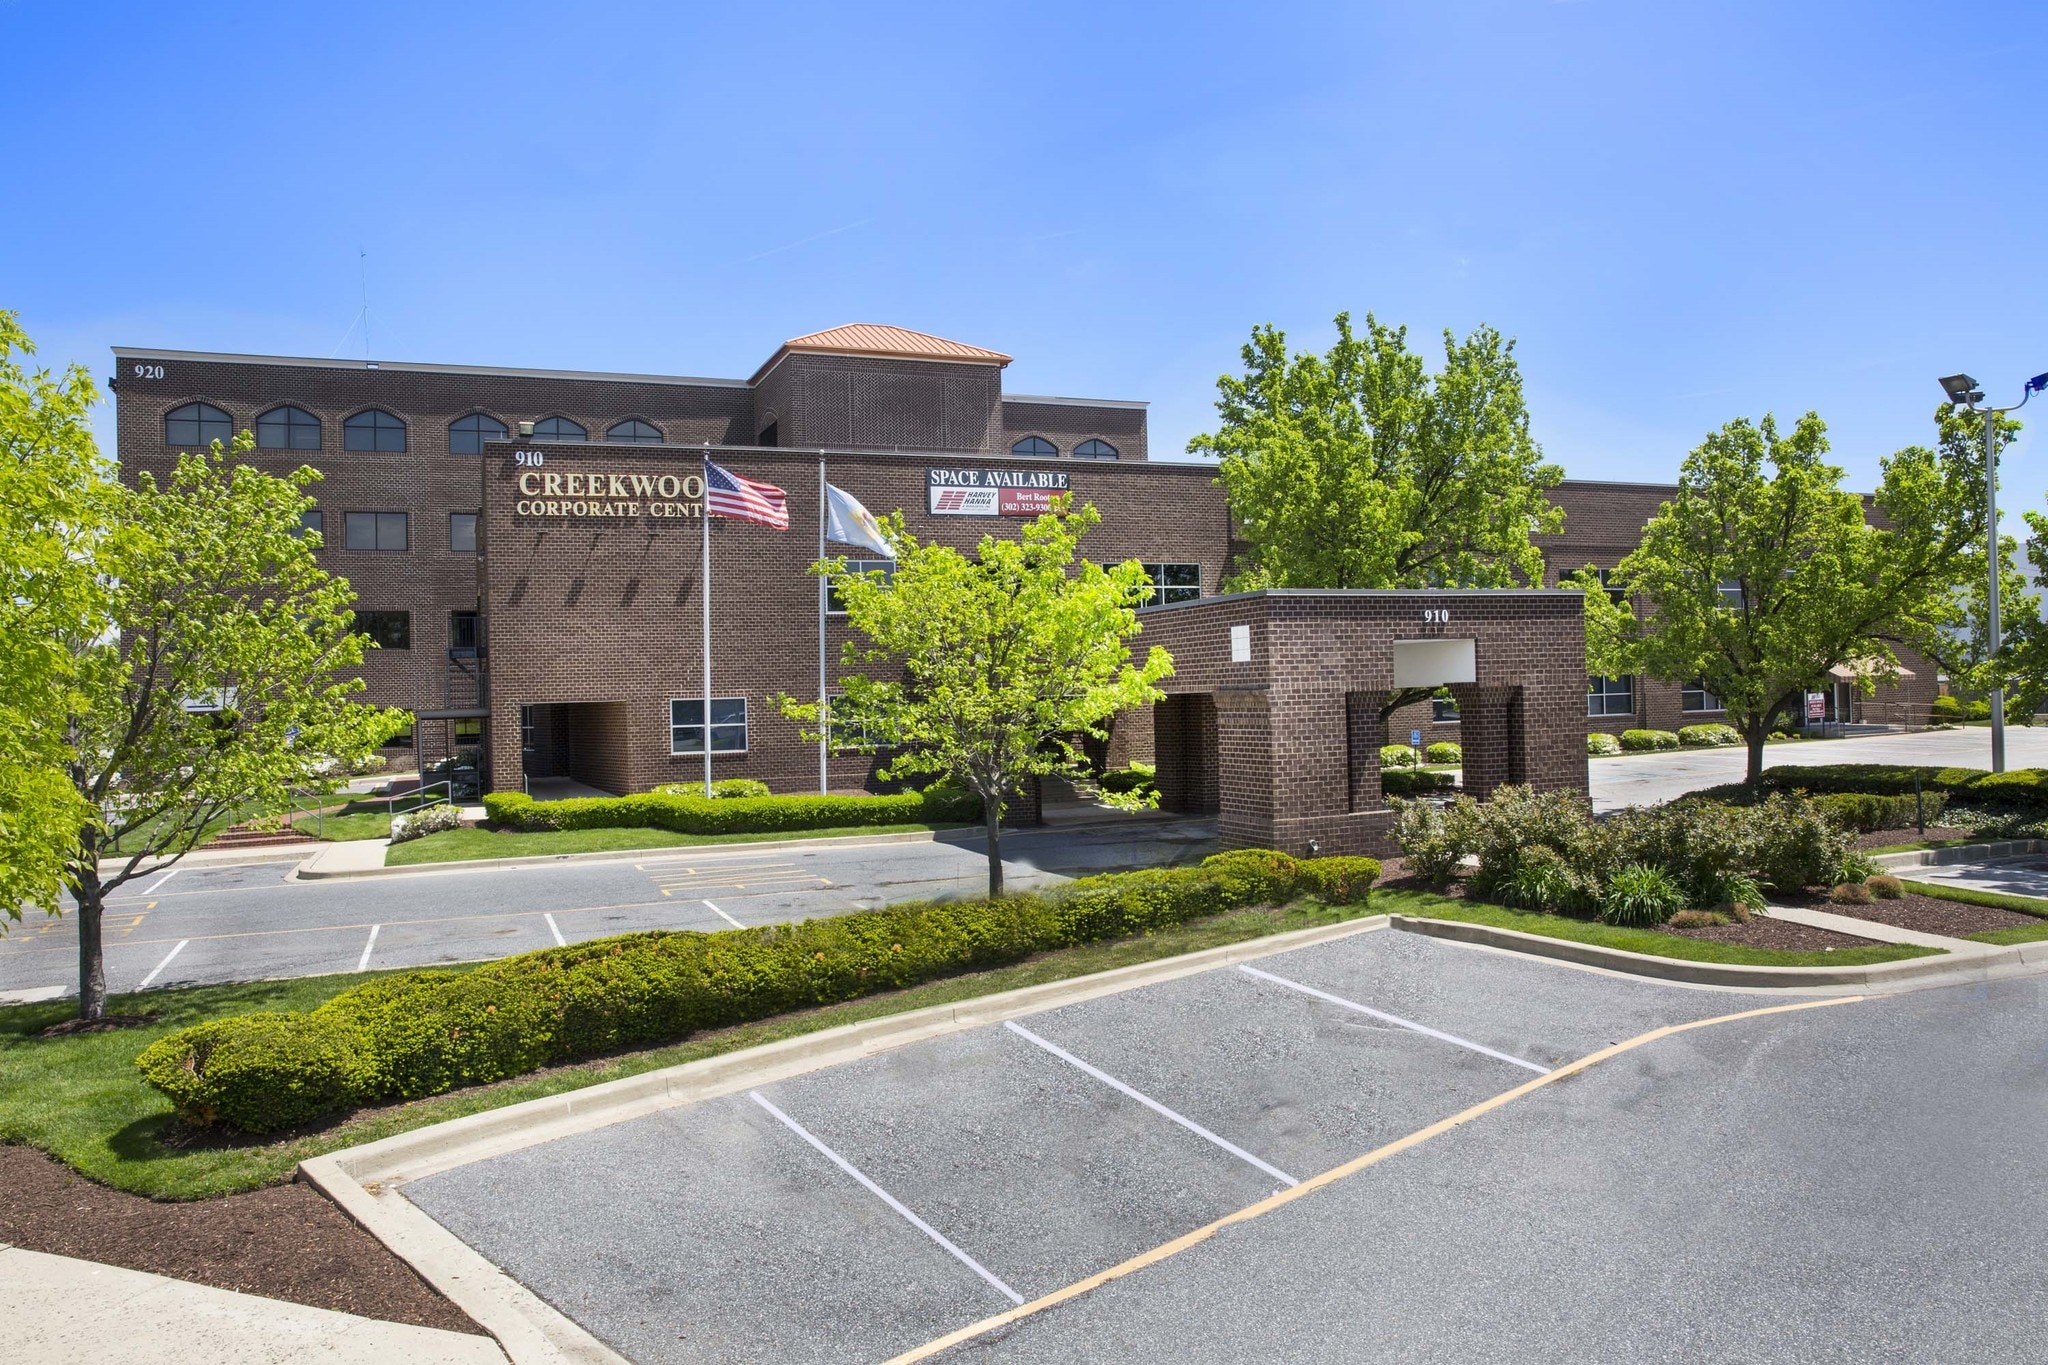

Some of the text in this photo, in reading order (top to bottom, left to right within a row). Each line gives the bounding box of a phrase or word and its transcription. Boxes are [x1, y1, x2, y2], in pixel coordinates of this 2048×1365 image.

[134, 364, 165, 379] 920
[515, 451, 544, 467] 910
[519, 472, 705, 499] CREEKWOO
[931, 469, 1068, 489] SPACE AVAILABLE
[967, 491, 996, 499] HARVEY
[1016, 492, 1032, 501] Bert
[517, 500, 728, 518] CORPORATE CENT
[1001, 502, 1020, 512] (302)
[1424, 609, 1449, 623] 910
